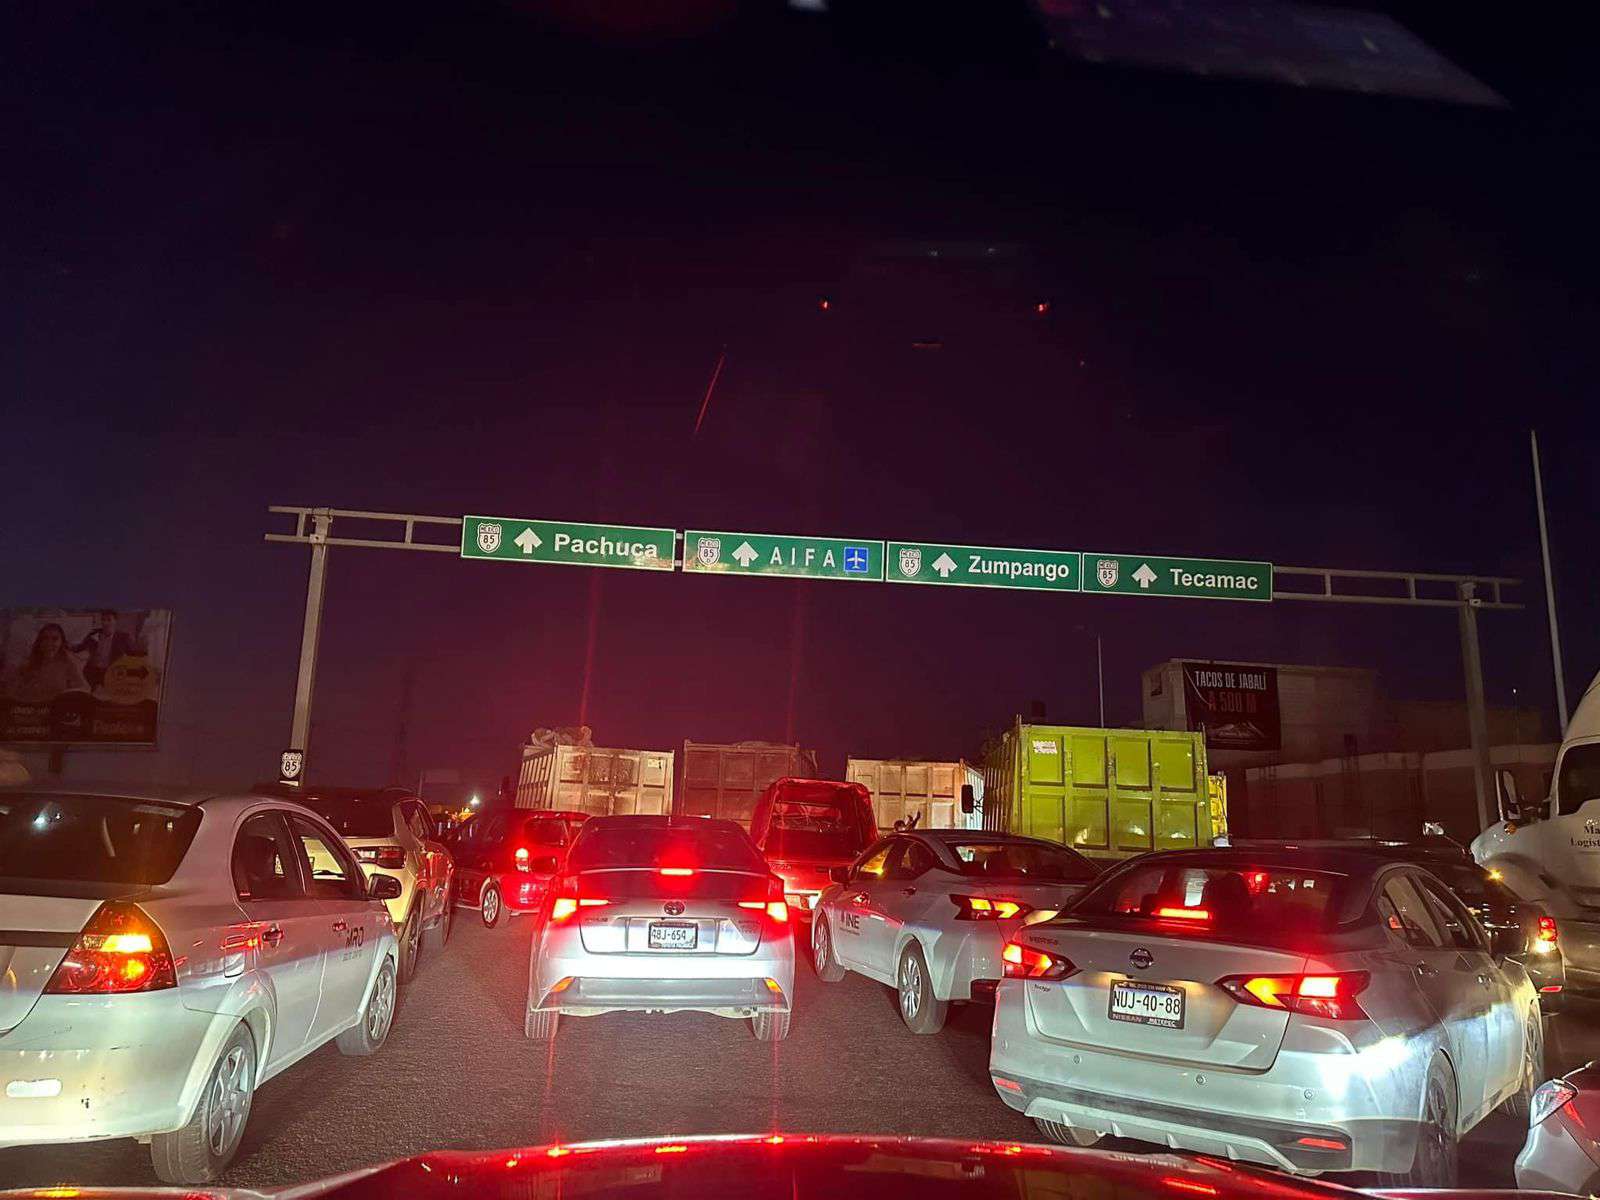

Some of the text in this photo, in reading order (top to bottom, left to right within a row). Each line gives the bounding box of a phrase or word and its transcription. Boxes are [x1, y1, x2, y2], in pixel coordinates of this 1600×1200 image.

[483, 534, 495, 544] 85
[554, 532, 658, 558] Pachuca
[703, 548, 714, 558] 85
[769, 546, 836, 568] AIFA
[904, 559, 916, 569] 85
[968, 555, 1070, 581] Zumpango
[1102, 570, 1113, 579] 85
[1169, 568, 1259, 590] Tecamac
[1194, 671, 1223, 688] TACOS
[1225, 672, 1236, 689] DE
[1219, 691, 1243, 713] 500
[284, 761, 297, 772] 85
[1113, 990, 1181, 1015] NUJ-40-88
[1112, 1013, 1142, 1023] NISSAN
